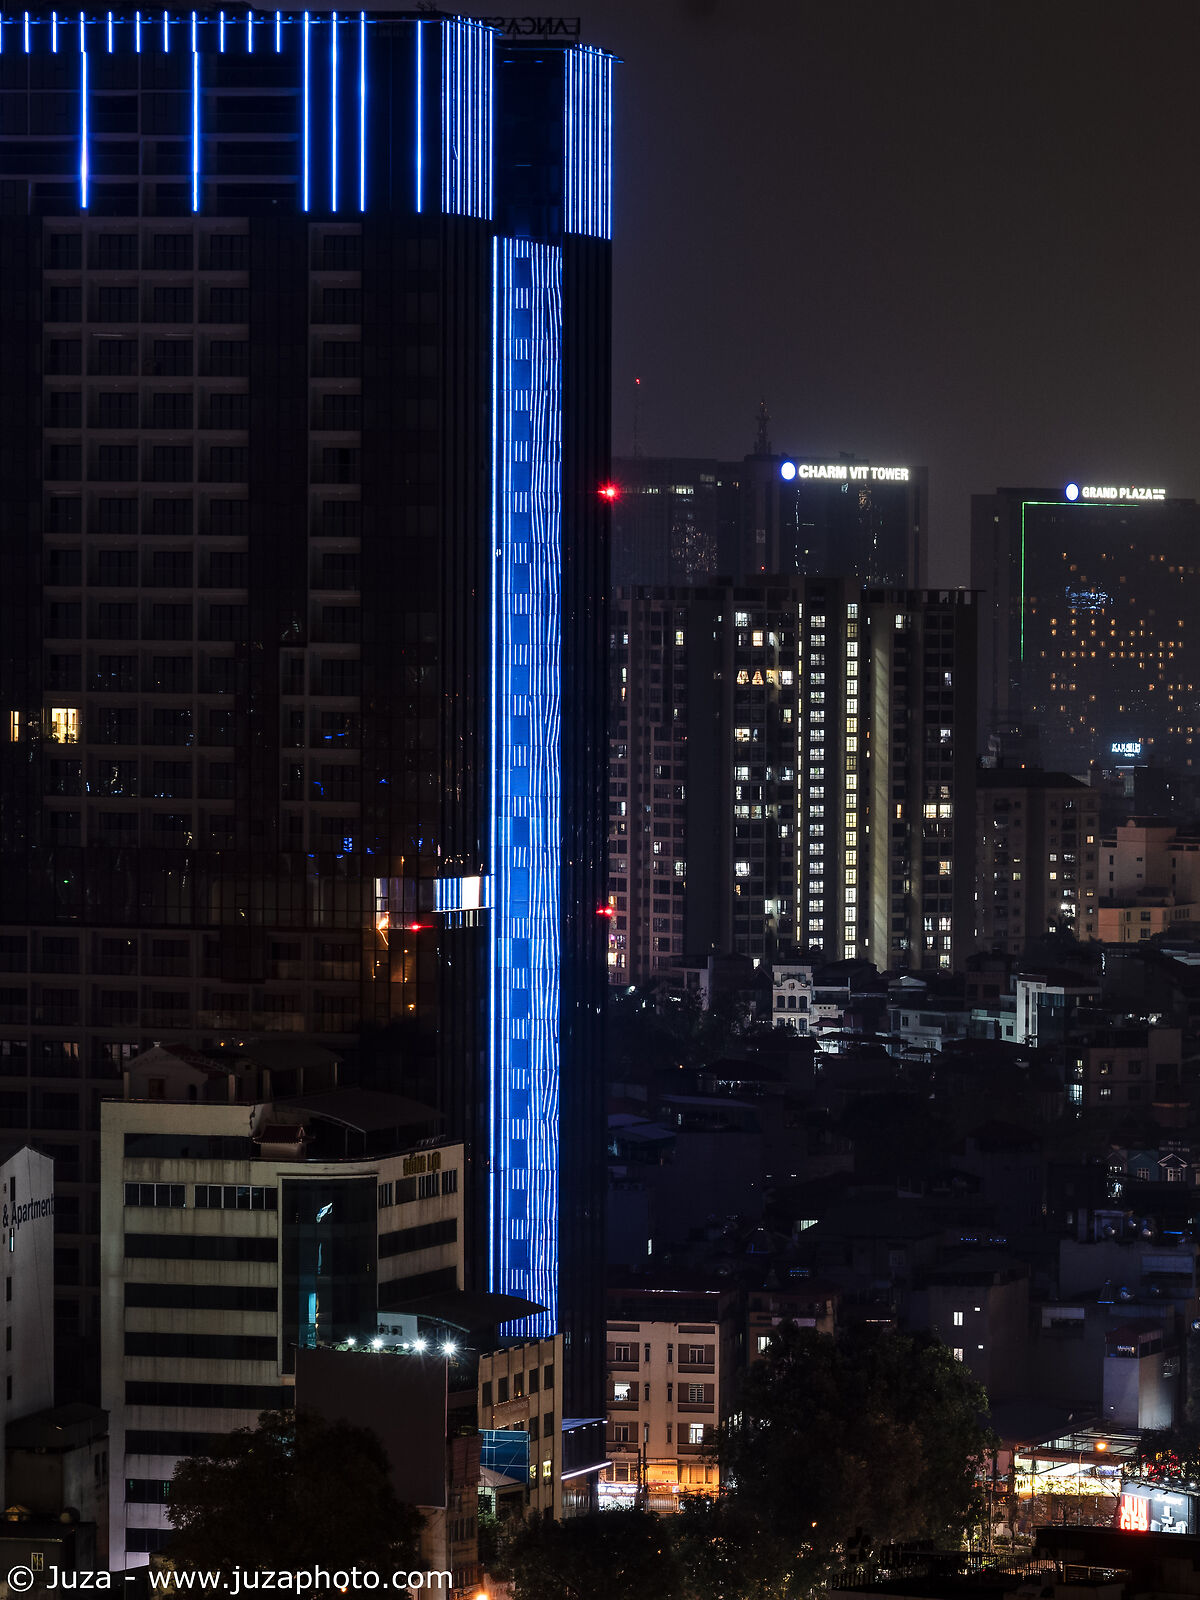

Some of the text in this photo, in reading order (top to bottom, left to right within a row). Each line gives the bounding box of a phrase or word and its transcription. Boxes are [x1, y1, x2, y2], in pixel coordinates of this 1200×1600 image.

[798, 464, 909, 480] CHARM VIT TOWER
[1082, 486, 1118, 498] GRAND
[1119, 487, 1153, 499] PLAZA
[3, 1203, 9, 1228] &
